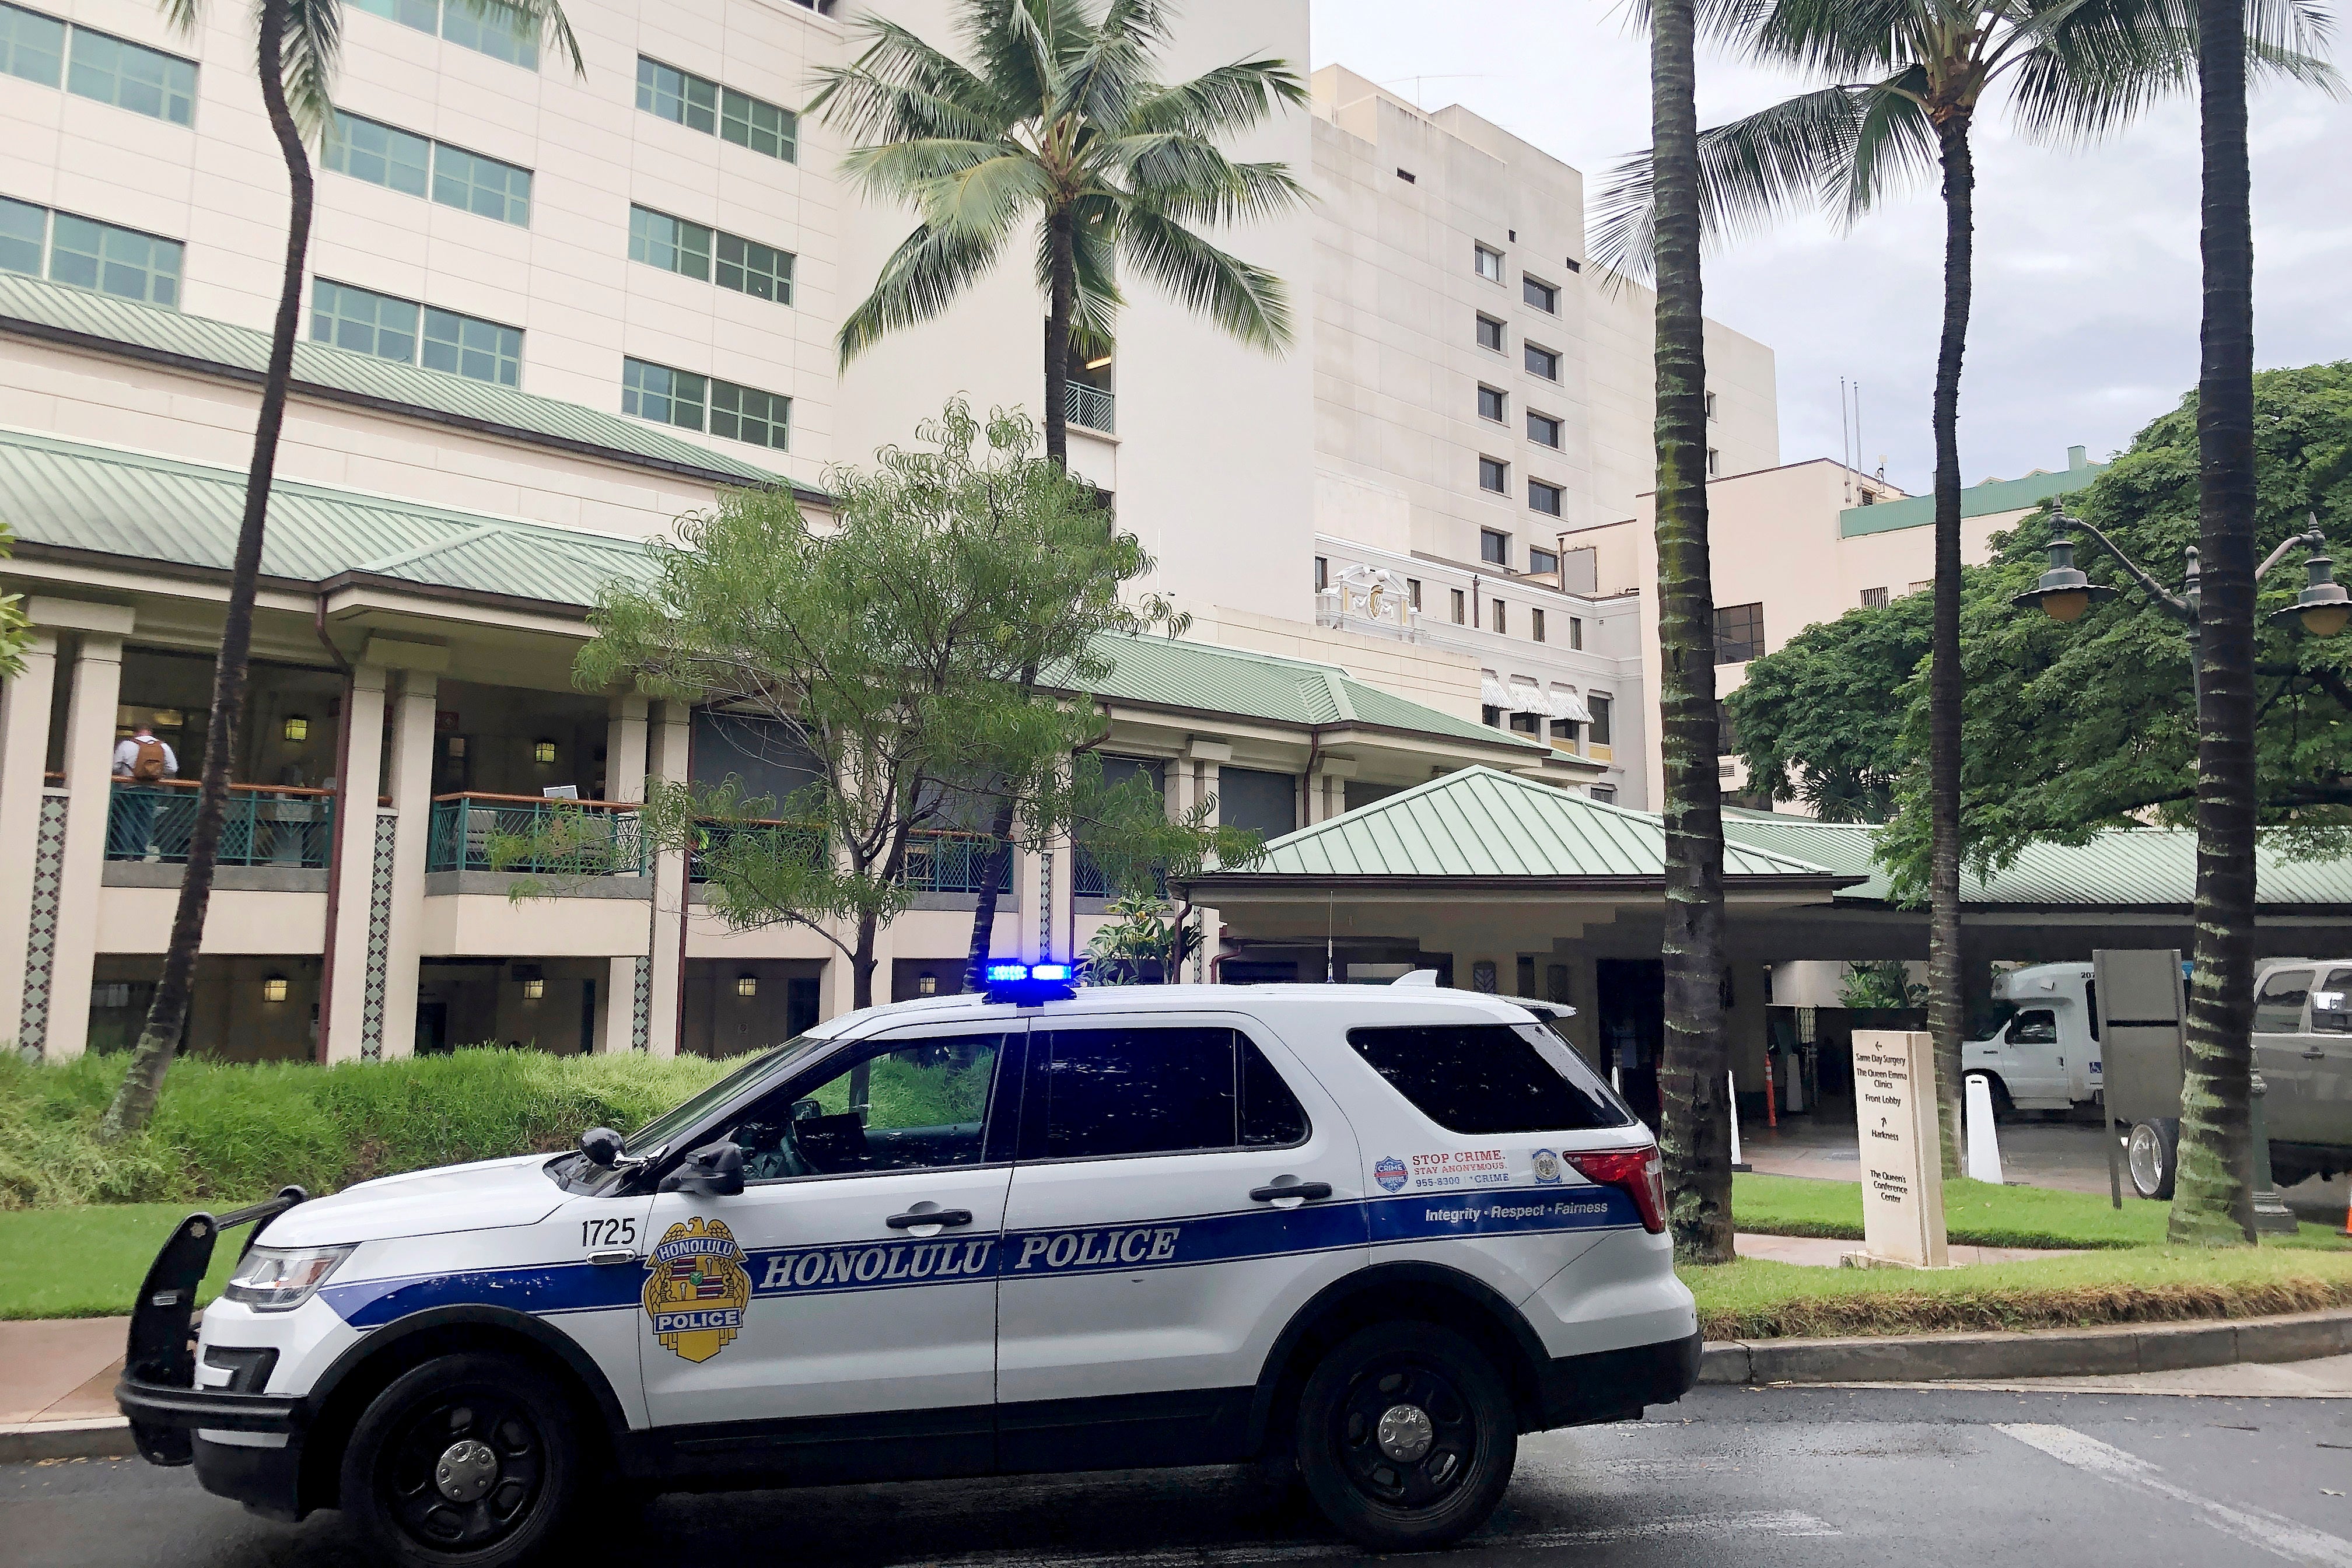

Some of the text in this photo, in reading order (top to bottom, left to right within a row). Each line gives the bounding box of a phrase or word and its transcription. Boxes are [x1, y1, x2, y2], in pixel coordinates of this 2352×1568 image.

[1856, 1053, 1906, 1066] Same Day Surgery
[1857, 1068, 1908, 1080] The Queen Emma
[1874, 1079, 1893, 1088] Clinics
[1866, 1093, 1901, 1107] Front Lobby
[1871, 1129, 1899, 1141] Harkness
[1412, 1150, 1506, 1166] STOP CRIME.
[1377, 1164, 1404, 1172] CRIME
[1413, 1162, 1507, 1175] STAY ANONYMOUS.
[1416, 1176, 1460, 1187] 955-8300
[1870, 1170, 1906, 1183] The Queen's
[1873, 1180, 1908, 1194] Conference
[1881, 1192, 1901, 1203] Center
[1425, 1202, 1608, 1223] Integrity Respect Fairness
[582, 1217, 635, 1247] 1725
[659, 1239, 734, 1260] HONOLULU
[759, 1227, 1180, 1289] HONOLULU POLICE
[658, 1310, 738, 1330] POLICE
